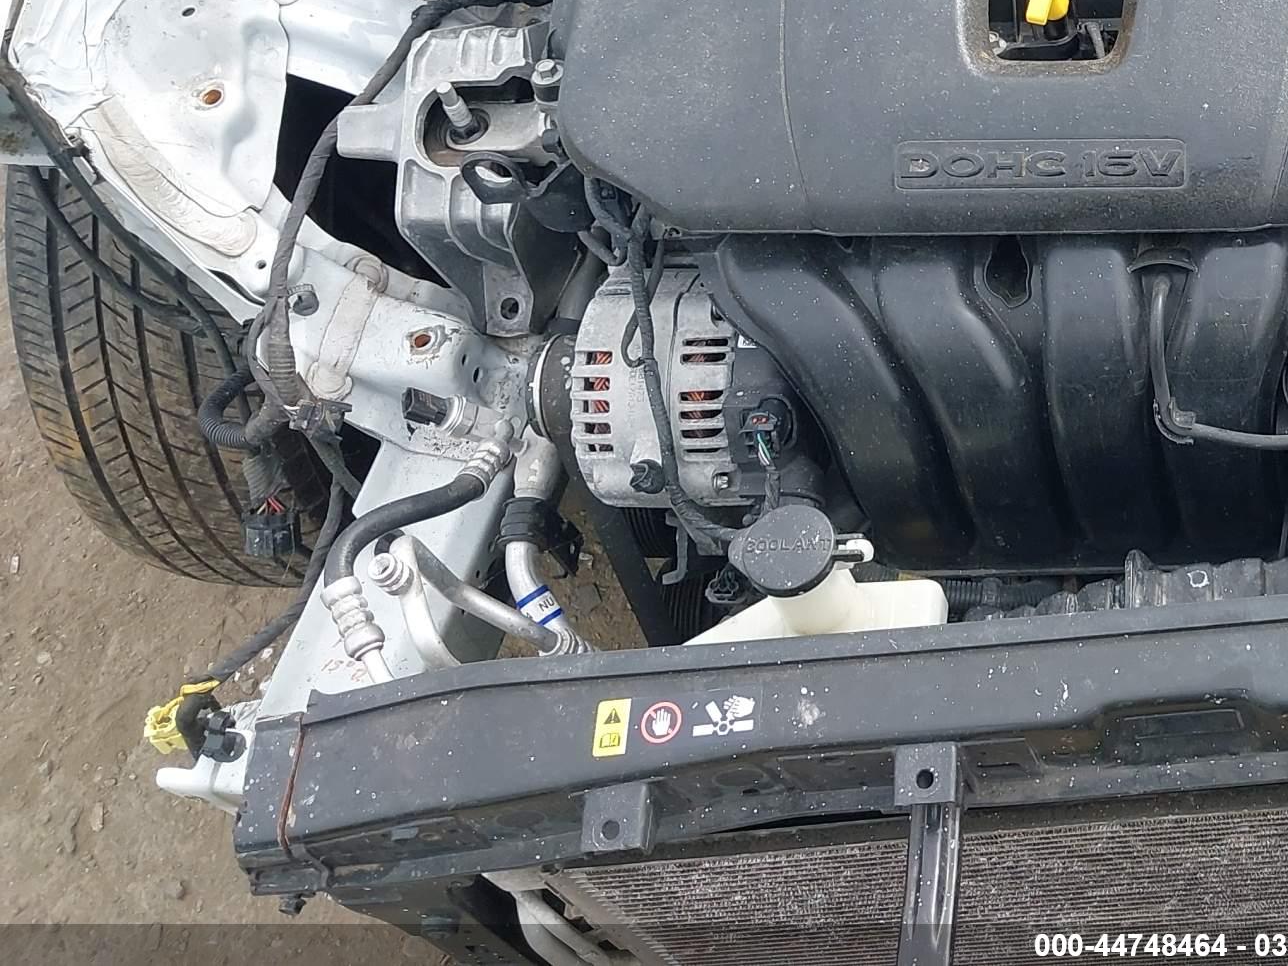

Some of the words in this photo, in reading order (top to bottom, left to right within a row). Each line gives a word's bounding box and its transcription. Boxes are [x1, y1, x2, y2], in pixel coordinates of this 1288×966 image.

[899, 150, 1067, 179] DOHC
[1082, 149, 1184, 178] 16V
[746, 537, 832, 553] COOLANT
[538, 596, 555, 612] NU
